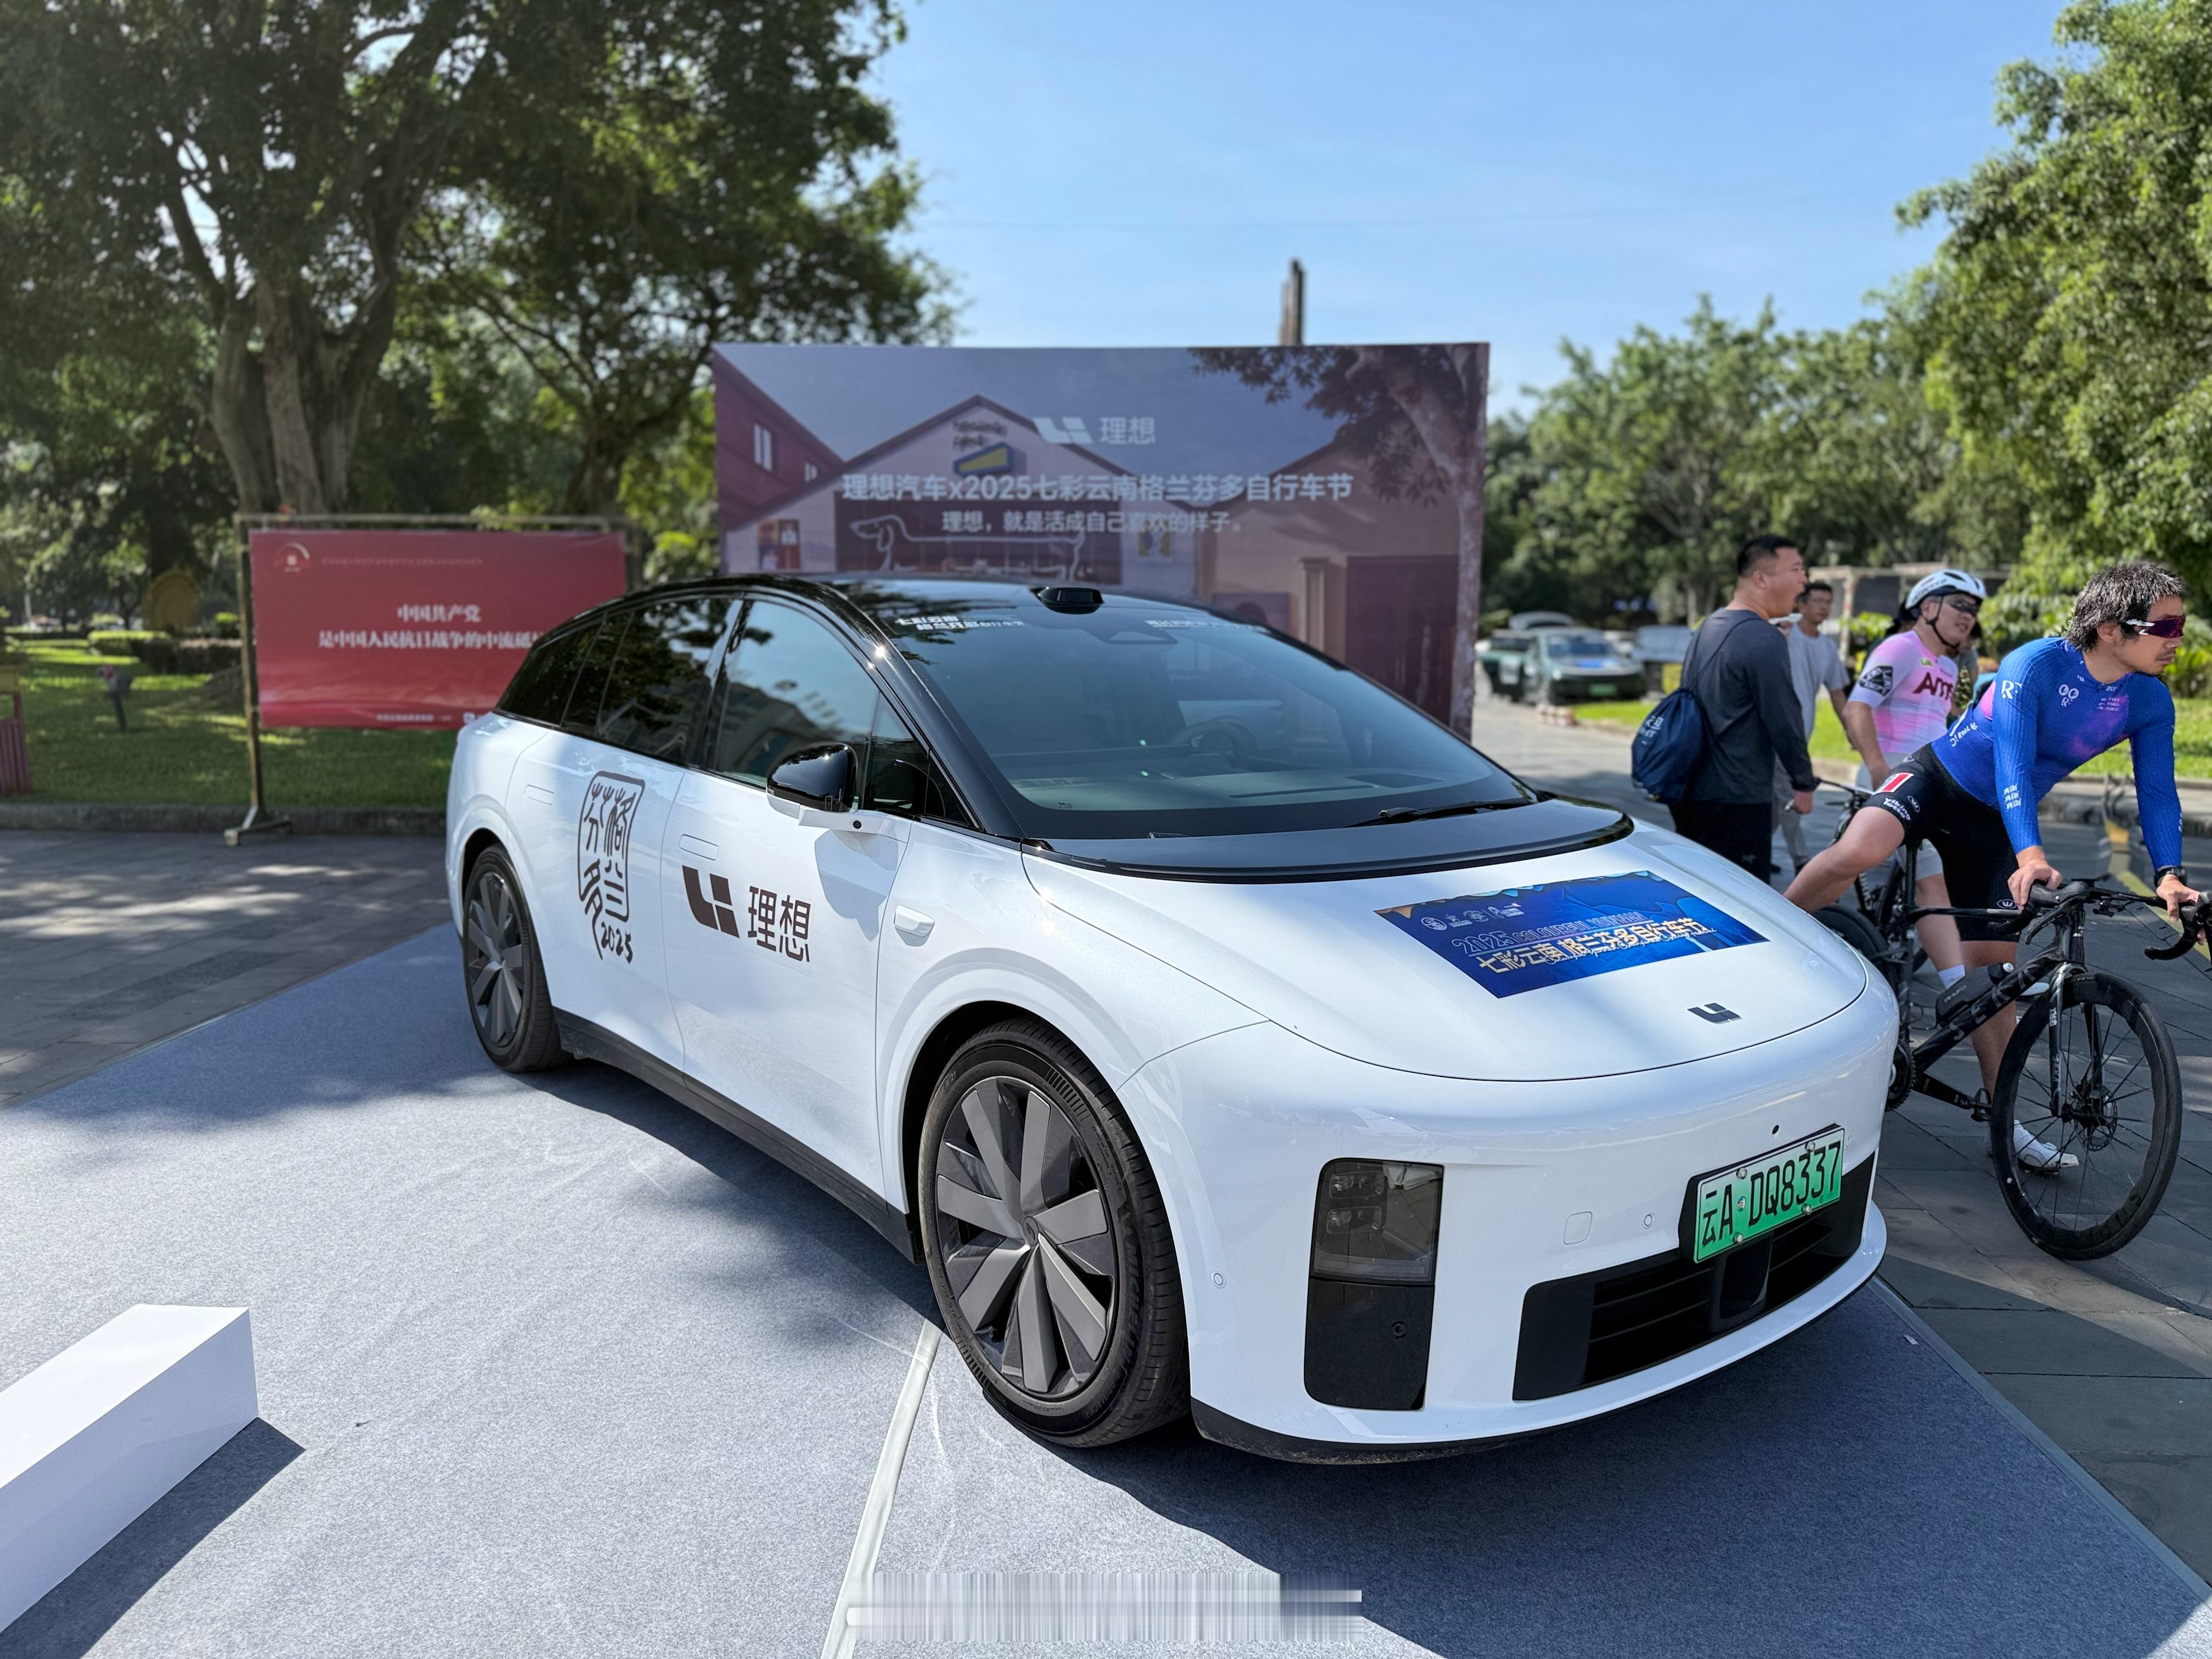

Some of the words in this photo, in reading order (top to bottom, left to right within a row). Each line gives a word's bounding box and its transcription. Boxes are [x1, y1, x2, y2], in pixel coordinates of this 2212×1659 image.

[1099, 417, 1155, 444] 理想
[397, 604, 481, 623] 中国共产党
[748, 885, 811, 963] 理想
[601, 922, 633, 964] 2025
[1452, 930, 1513, 955] 2025
